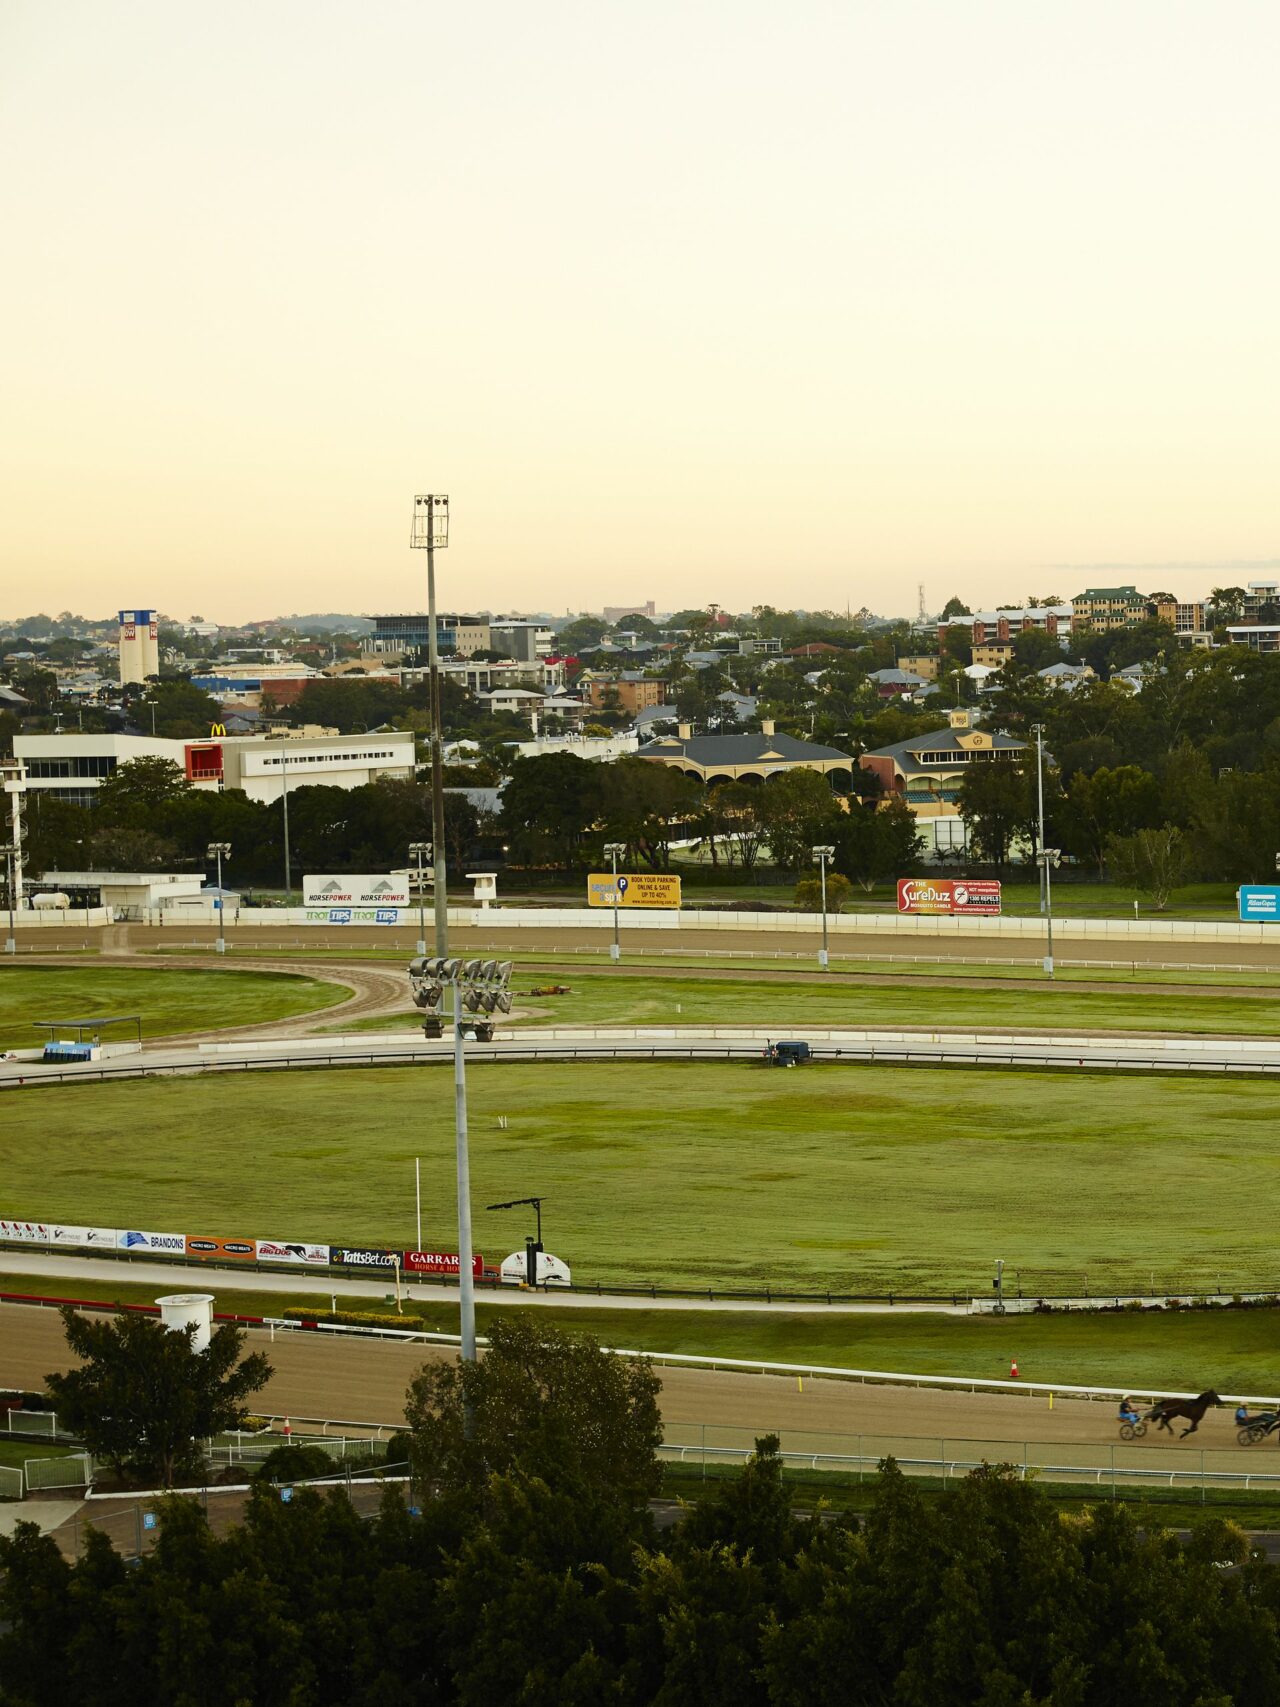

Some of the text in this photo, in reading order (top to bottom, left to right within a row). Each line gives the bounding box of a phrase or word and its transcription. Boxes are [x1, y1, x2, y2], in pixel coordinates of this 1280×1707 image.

[331, 911, 350, 920] TIPS
[378, 911, 396, 920] TIPS
[150, 1236, 184, 1250] BRANDONS
[342, 1250, 401, 1266] TattsBet.com
[410, 1253, 477, 1266] GARRARS
[414, 1263, 438, 1271] HORSE
